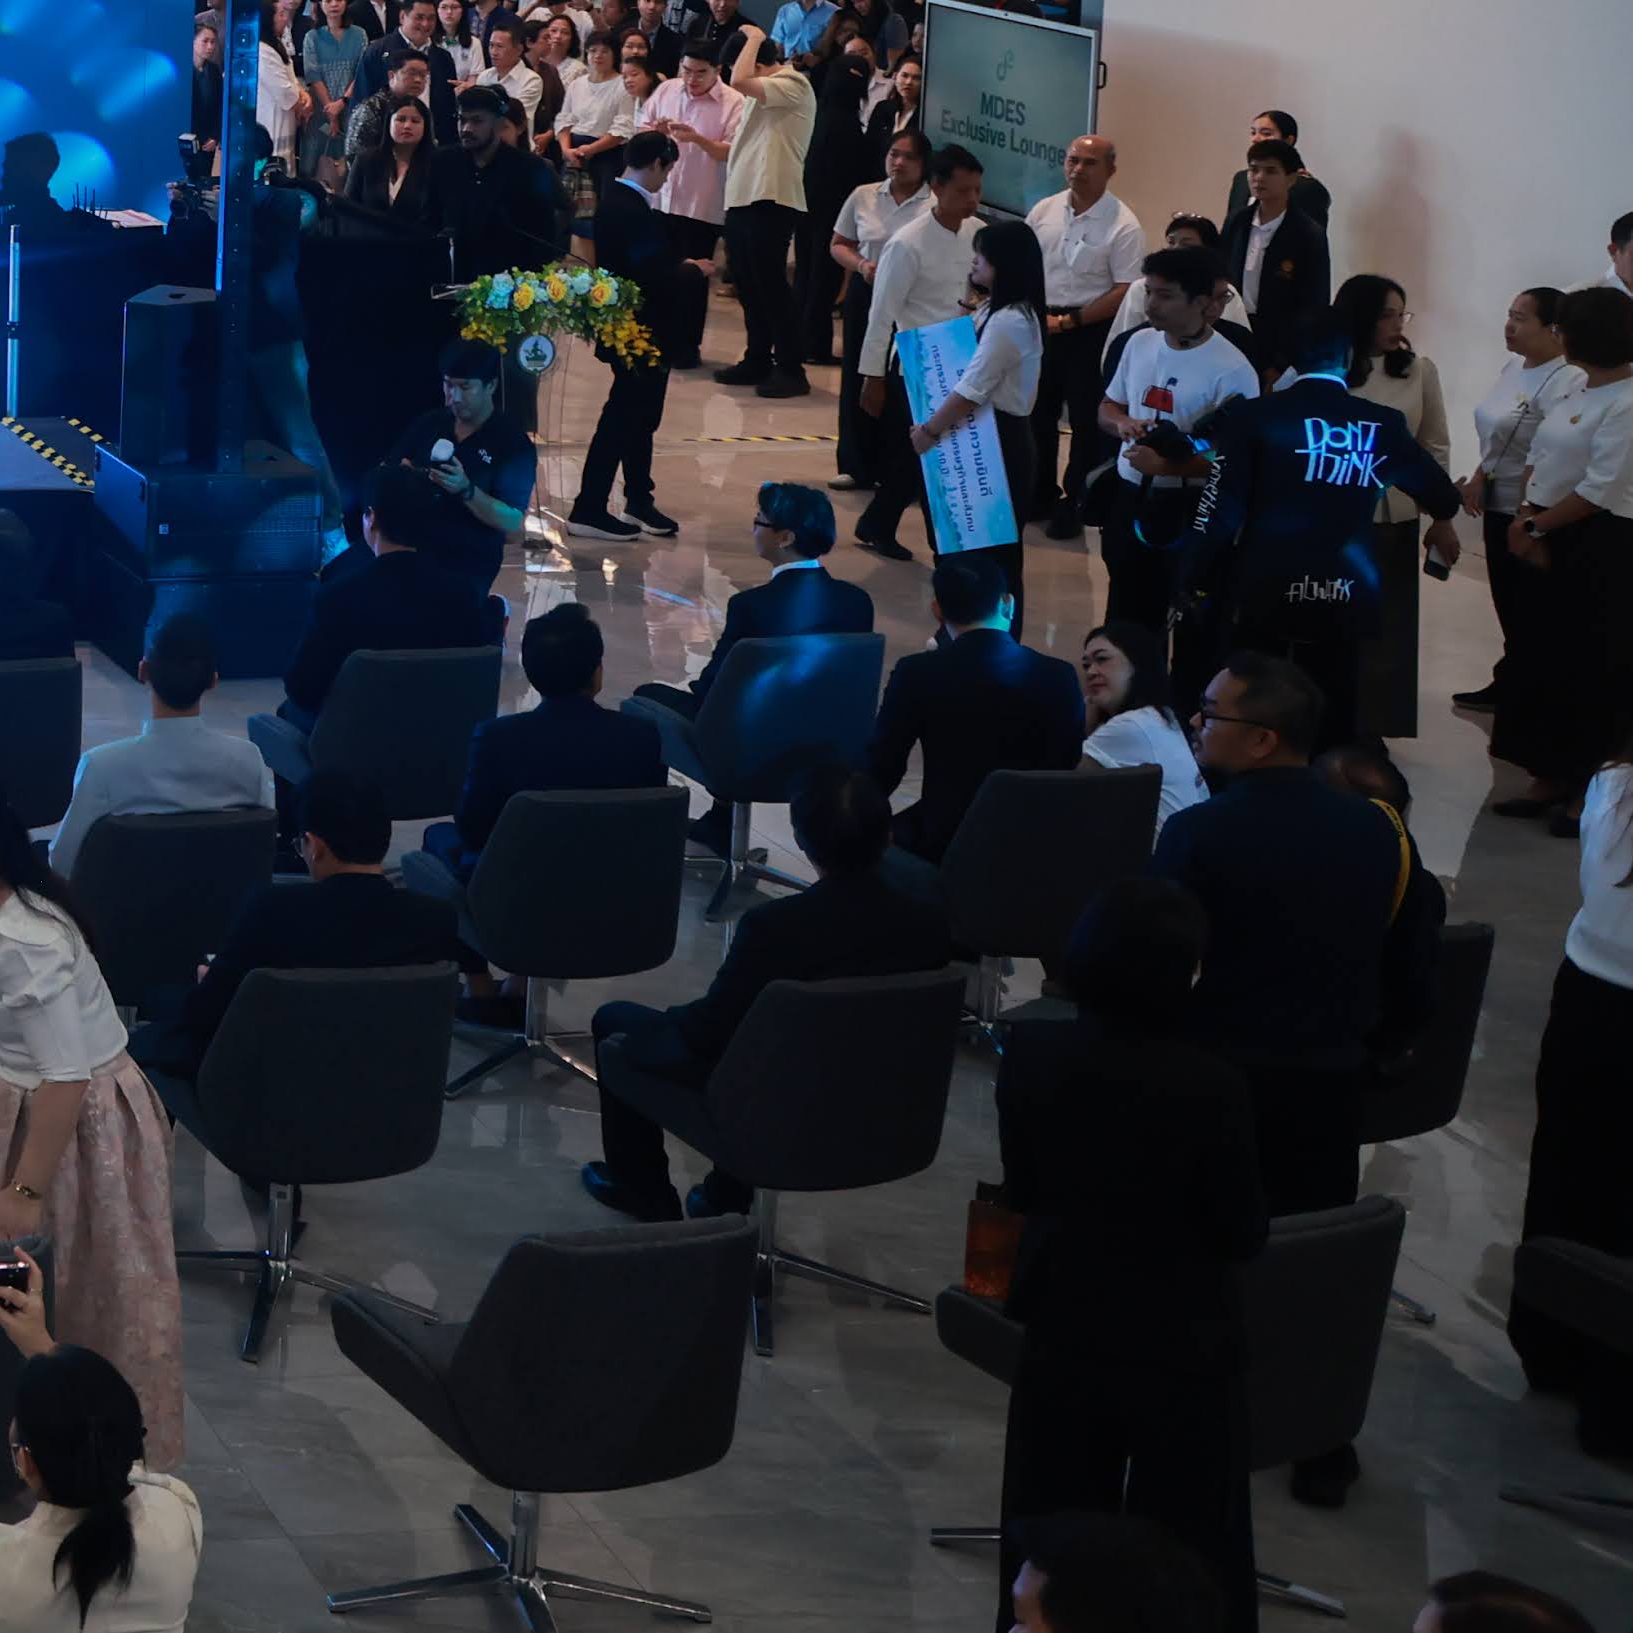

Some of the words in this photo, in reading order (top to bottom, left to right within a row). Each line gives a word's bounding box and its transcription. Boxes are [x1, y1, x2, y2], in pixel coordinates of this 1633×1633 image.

[980, 92, 1025, 126] MDES
[941, 109, 1006, 148] Exclusive
[1010, 128, 1066, 168] Lounge
